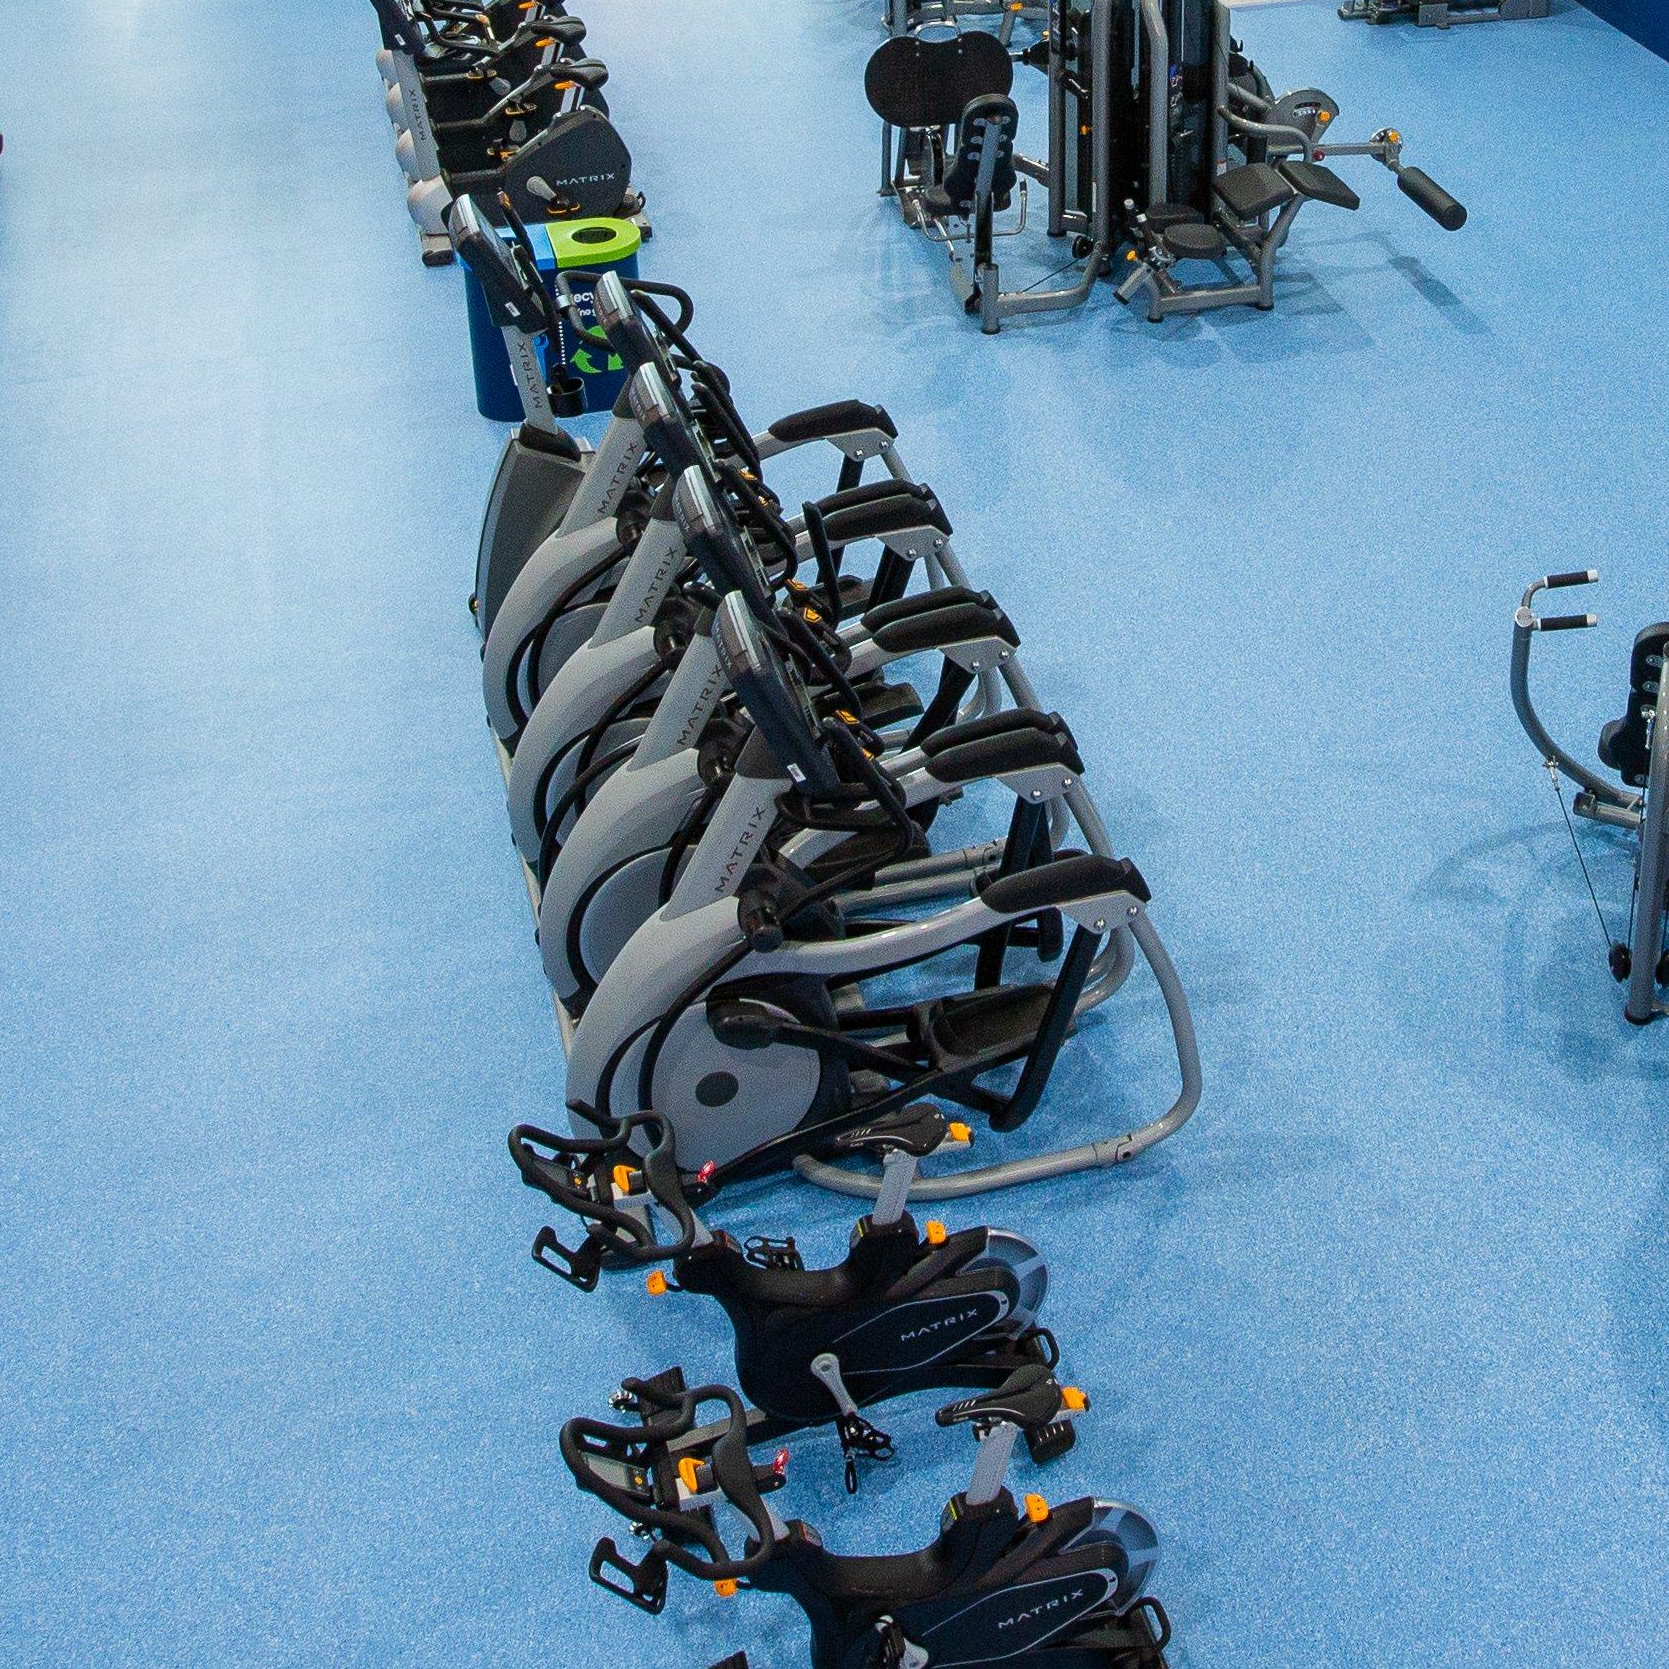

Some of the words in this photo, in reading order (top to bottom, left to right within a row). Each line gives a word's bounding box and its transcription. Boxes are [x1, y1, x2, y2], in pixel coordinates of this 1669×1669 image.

[408, 88, 427, 141] MATRIX
[556, 172, 615, 187] MATRIX
[517, 342, 543, 410] MATRIX
[598, 442, 639, 514] MATRIX
[635, 546, 678, 623] MATRIX
[677, 665, 723, 747] MATRIX
[715, 806, 767, 894] MATRIX
[900, 1308, 978, 1342] MATRIX
[998, 1588, 1084, 1630] MATRIX
